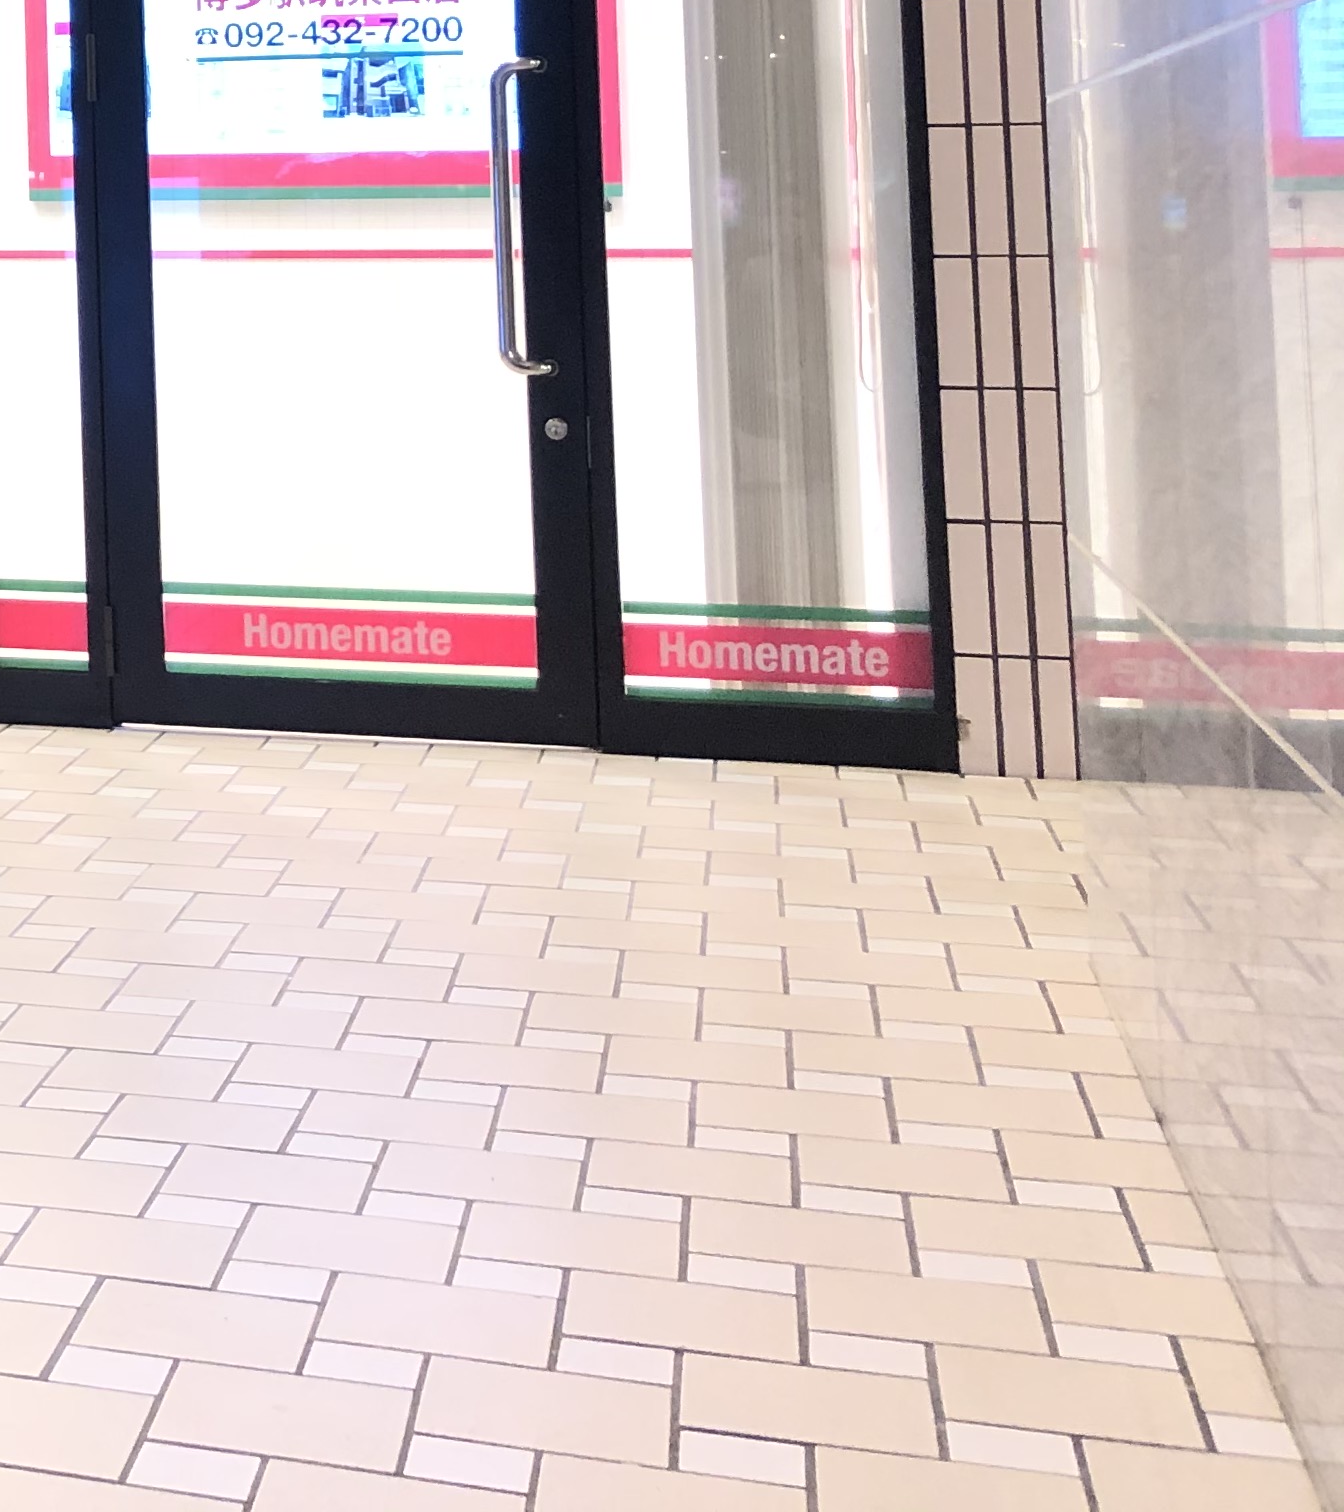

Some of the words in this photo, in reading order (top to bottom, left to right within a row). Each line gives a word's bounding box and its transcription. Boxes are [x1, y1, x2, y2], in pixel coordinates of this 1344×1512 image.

[224, 16, 464, 48] 092-432-7200
[243, 612, 452, 656] Homemate
[659, 631, 889, 677] Homemate
